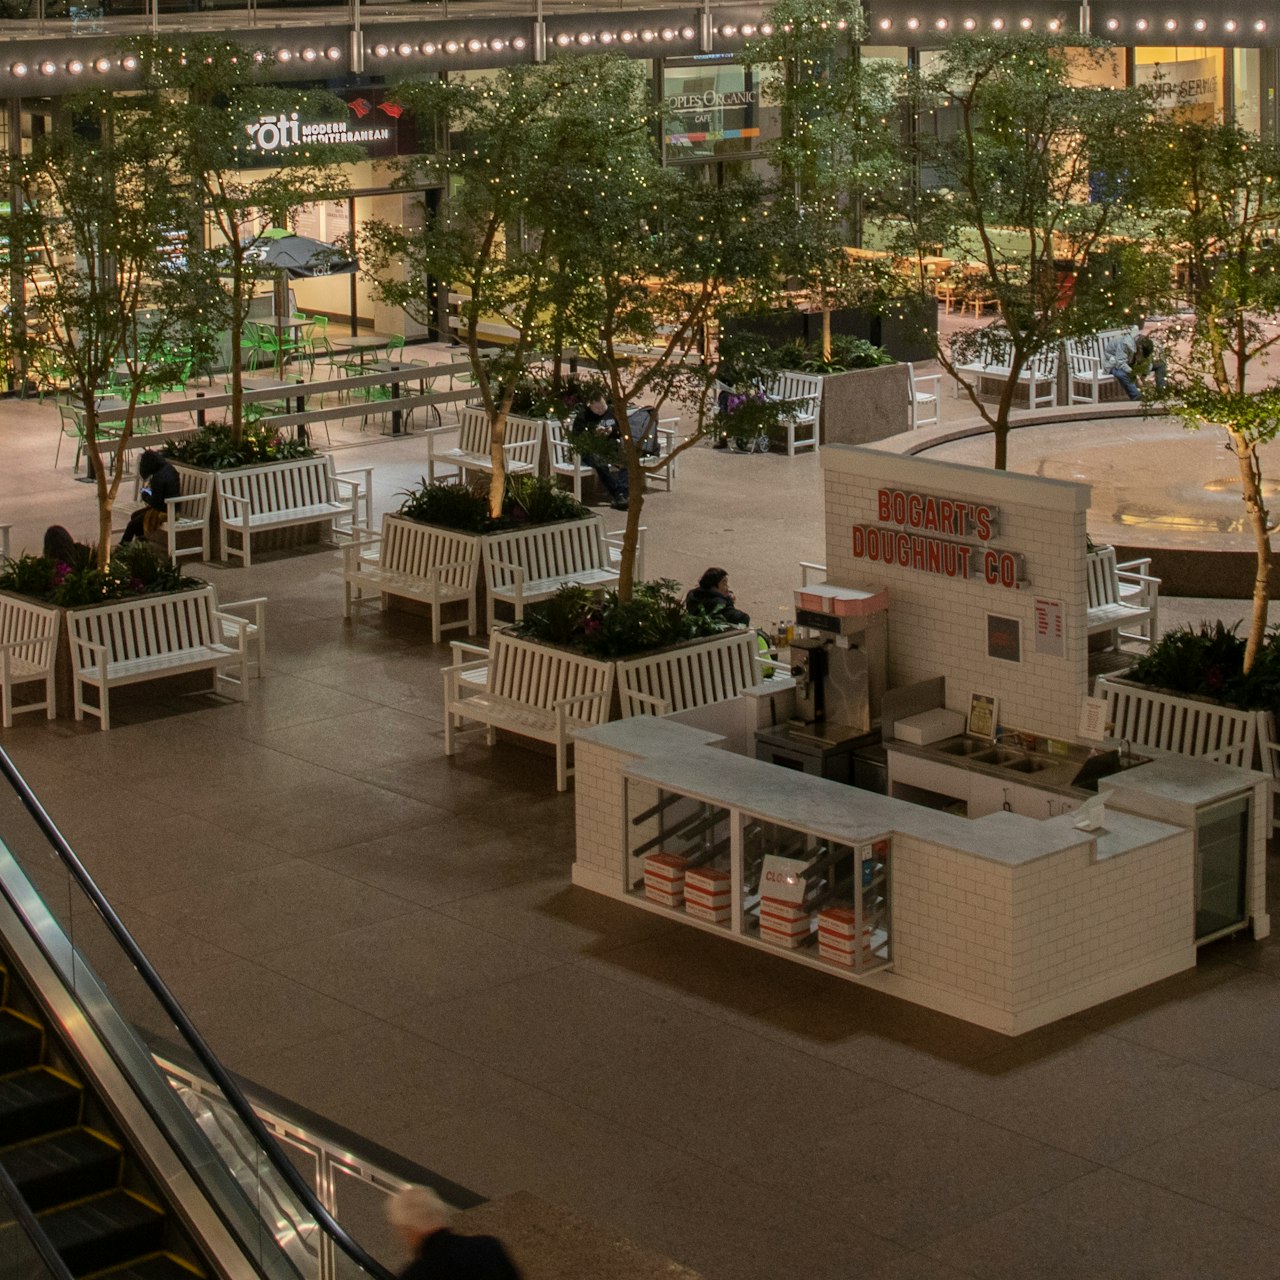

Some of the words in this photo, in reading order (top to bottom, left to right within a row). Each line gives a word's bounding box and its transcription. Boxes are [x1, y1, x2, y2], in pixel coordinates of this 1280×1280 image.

[302, 122, 347, 135] MODERN
[302, 128, 389, 144] MEDITERRANEAN
[877, 487, 993, 543] BOGART'S
[851, 524, 971, 580] DOUGHNUT
[983, 548, 1022, 590] CO.
